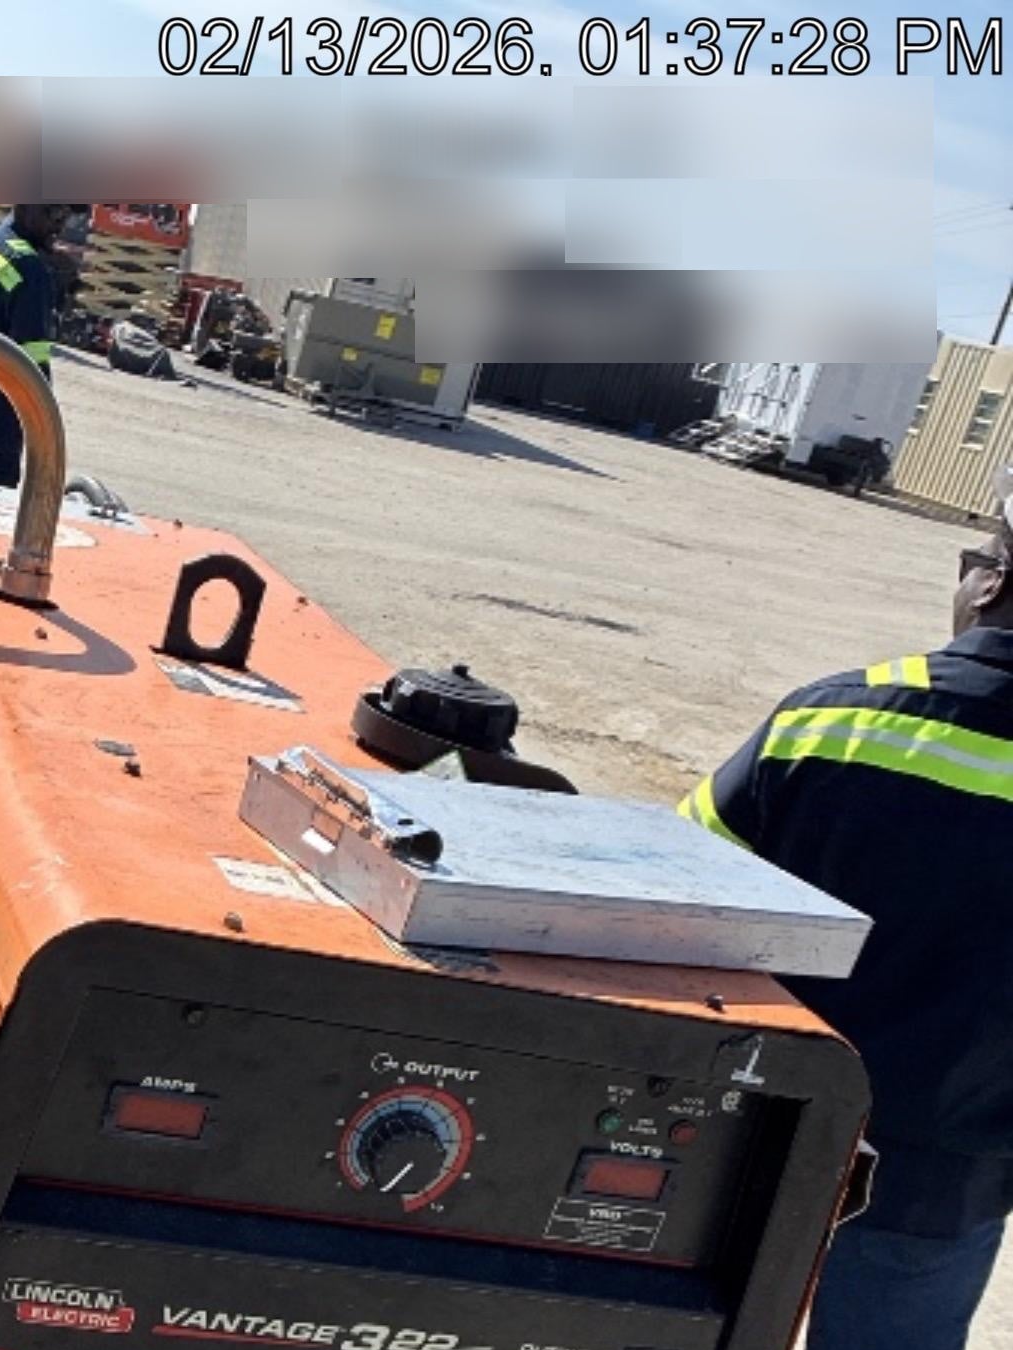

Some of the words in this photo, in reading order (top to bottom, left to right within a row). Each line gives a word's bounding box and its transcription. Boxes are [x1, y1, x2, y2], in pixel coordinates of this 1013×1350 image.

[403, 1061, 480, 1081] OUTPUT
[140, 1075, 197, 1093] AMPS
[610, 1140, 663, 1159] VOLTS
[10, 1283, 115, 1311] LINCOLN
[30, 1307, 121, 1328] ELECTRIC
[162, 1303, 339, 1345] VANTAGE
